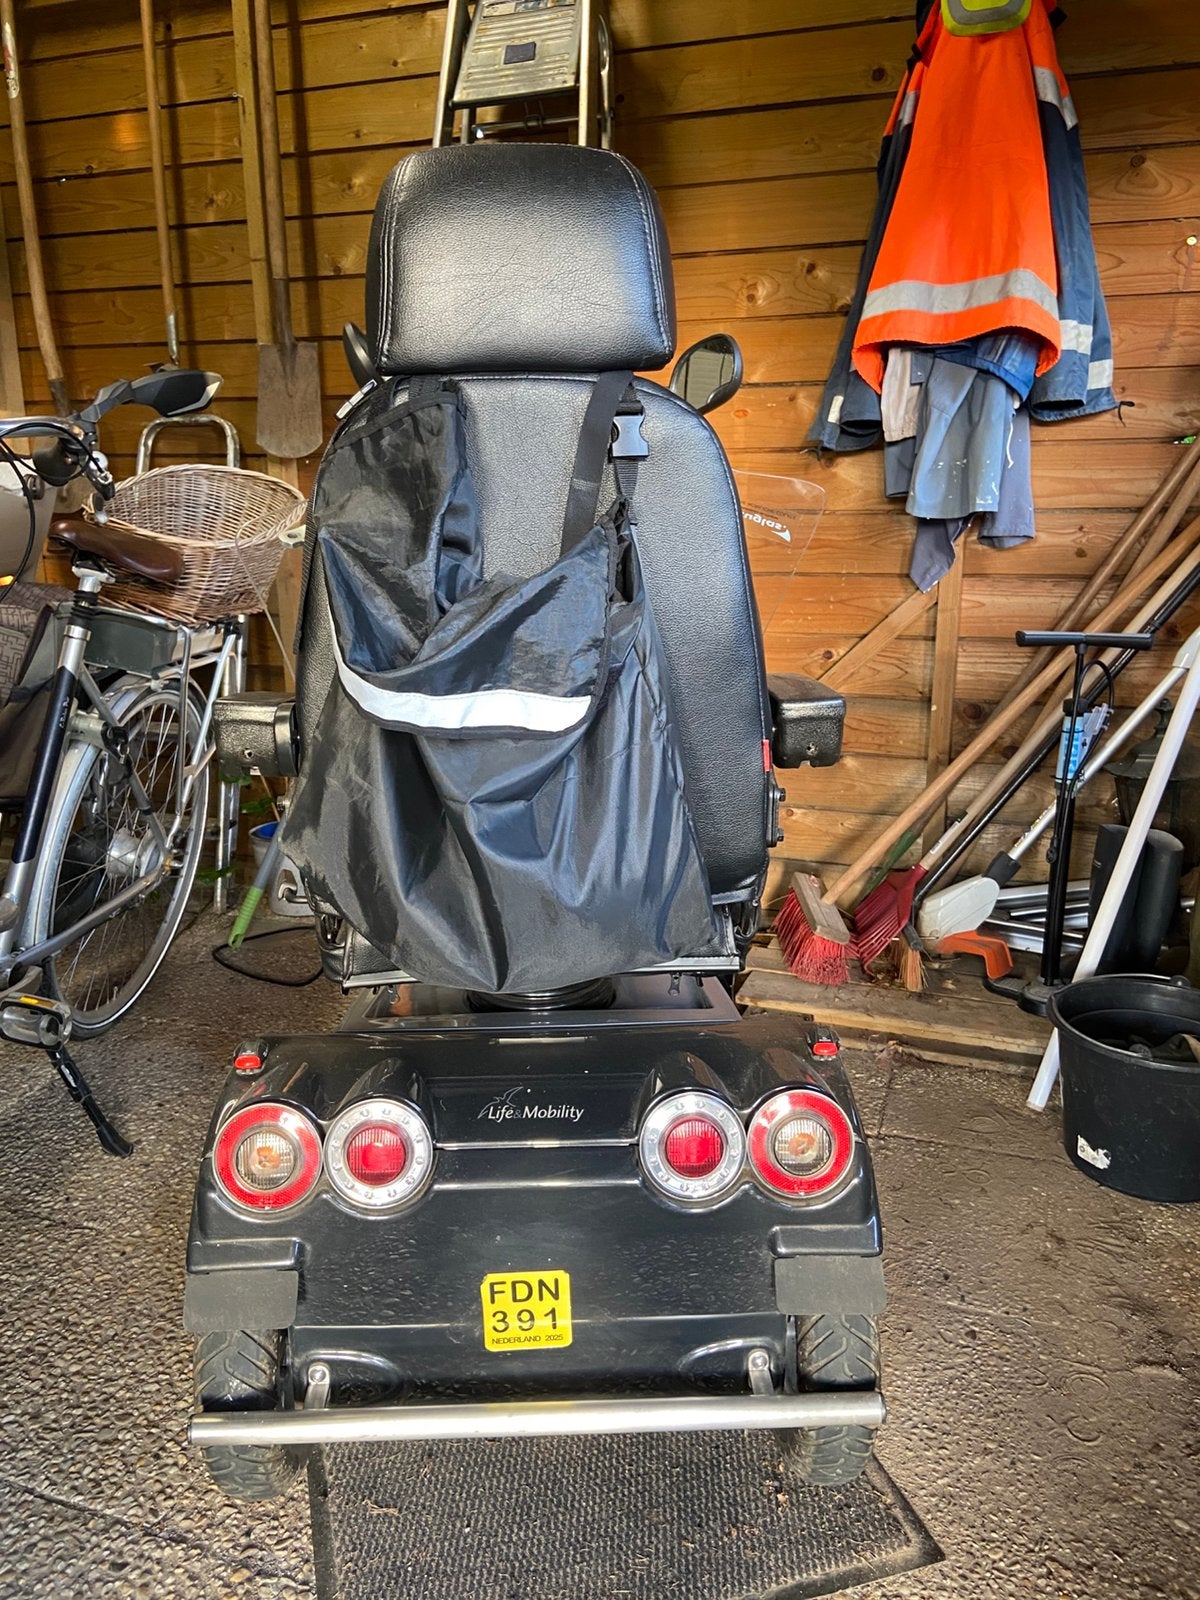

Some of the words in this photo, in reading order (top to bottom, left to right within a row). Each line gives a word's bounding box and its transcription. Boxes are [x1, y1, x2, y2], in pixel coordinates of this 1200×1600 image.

[489, 1277, 560, 1304] FDN
[492, 1307, 557, 1333] 391
[491, 1335, 541, 1345] NEDERLAND
[545, 1334, 564, 1342] 2025
